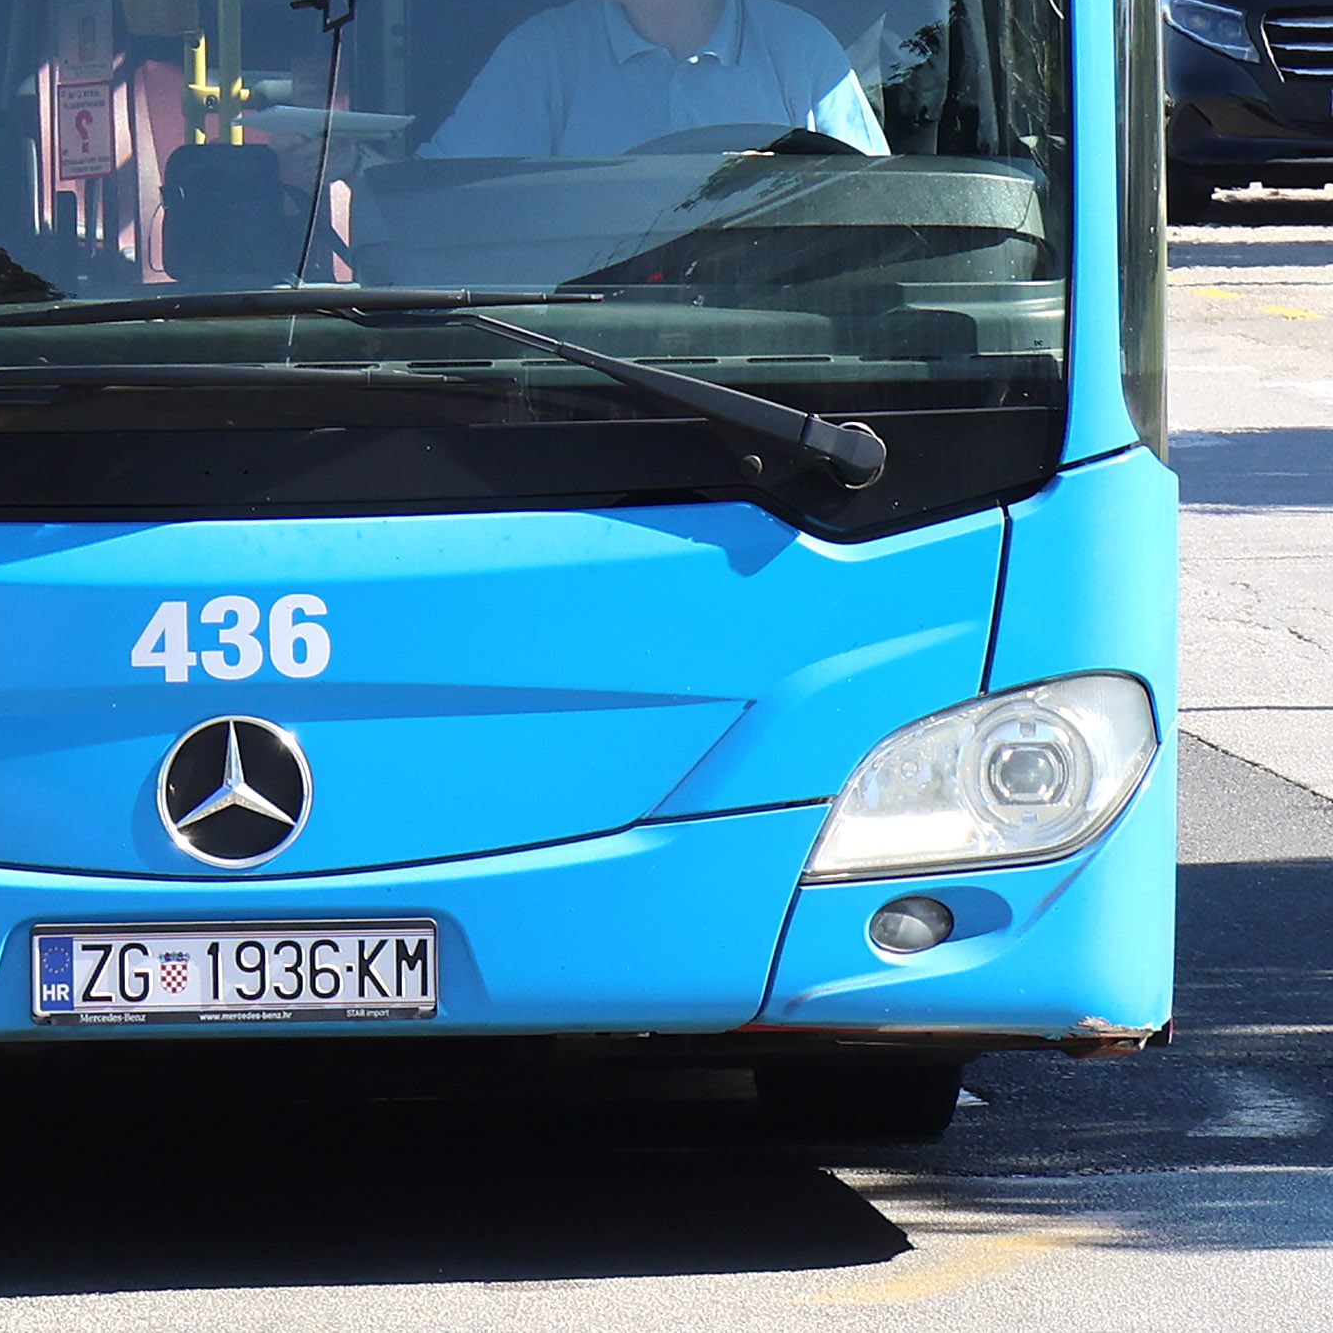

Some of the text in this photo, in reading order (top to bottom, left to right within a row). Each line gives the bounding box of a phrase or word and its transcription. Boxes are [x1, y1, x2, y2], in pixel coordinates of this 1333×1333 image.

[129, 593, 332, 683] 436
[42, 983, 70, 1003] HR
[80, 942, 151, 1004] ZG
[78, 1007, 391, 1024] Mercedes-Benz www.mercedes-benz.hr STAR import
